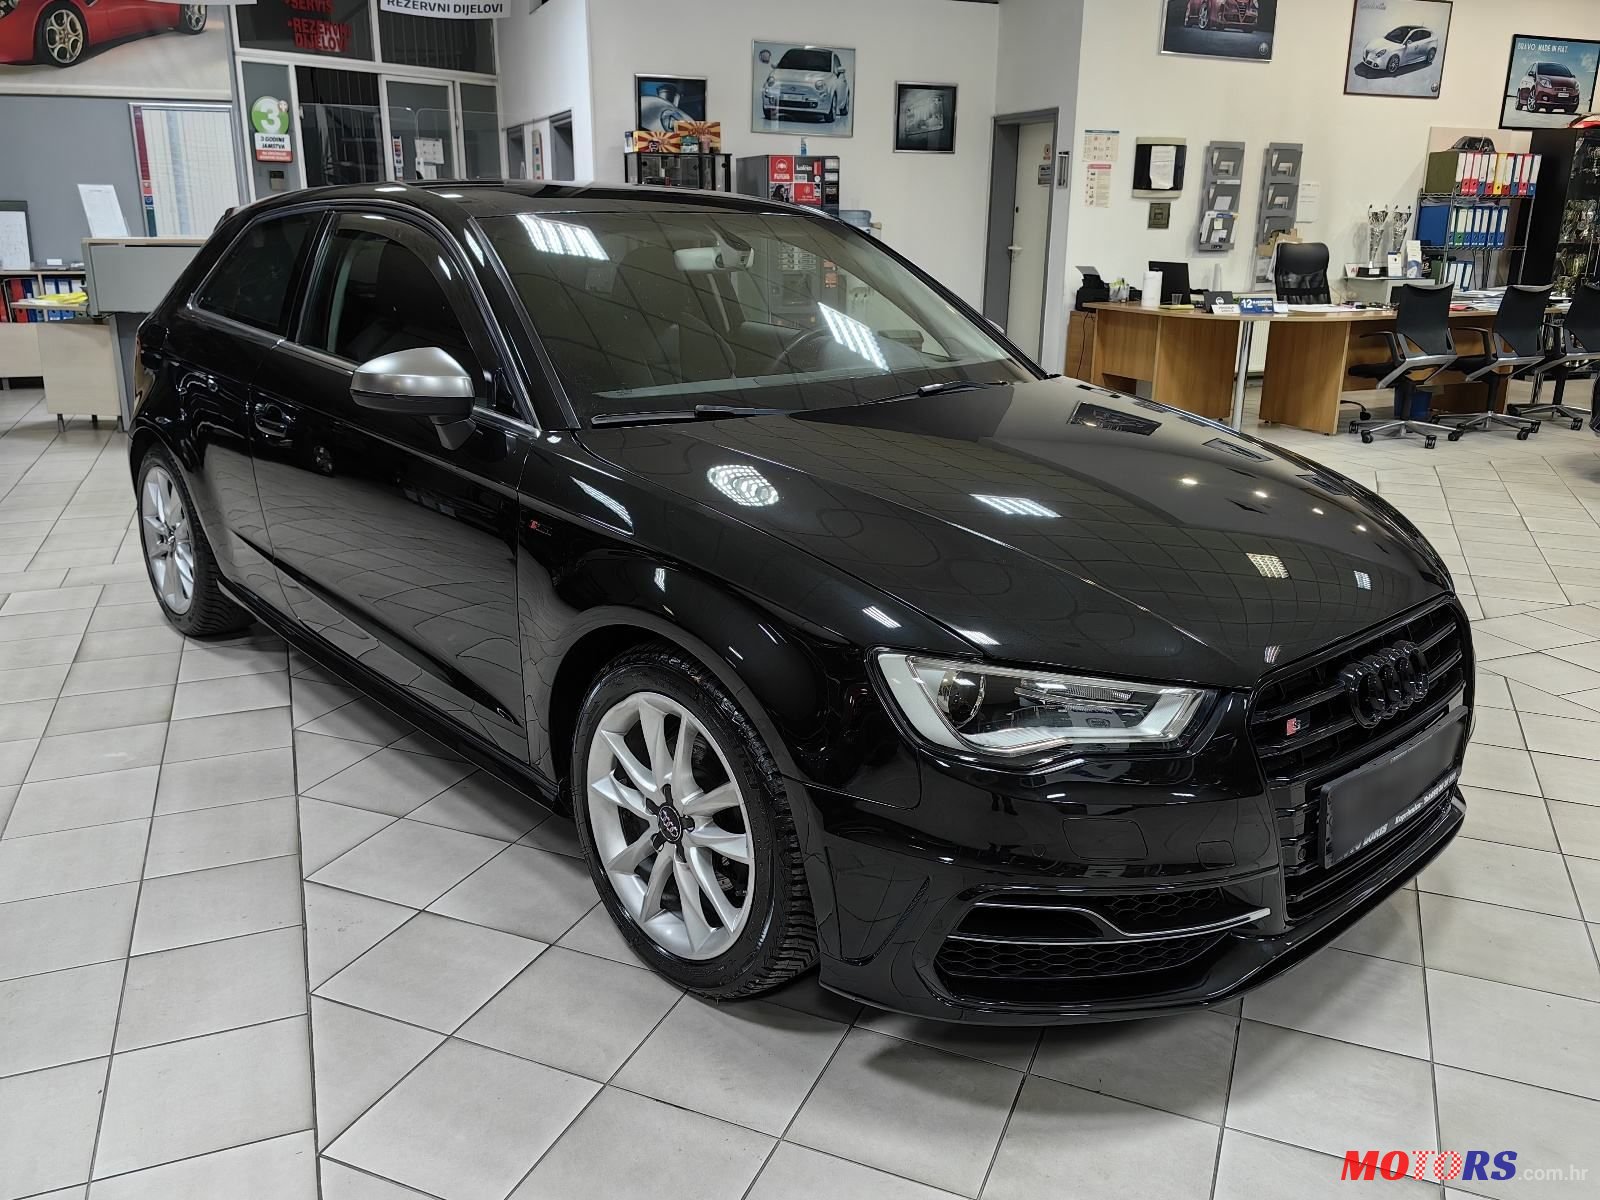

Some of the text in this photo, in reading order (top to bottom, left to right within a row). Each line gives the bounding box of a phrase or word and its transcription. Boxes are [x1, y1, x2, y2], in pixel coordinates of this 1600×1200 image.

[387, 0, 503, 16] REZERVNI DIJELOVI
[1538, 44, 1551, 52] MADE
[260, 98, 282, 134] 3
[1241, 299, 1253, 309] 12
